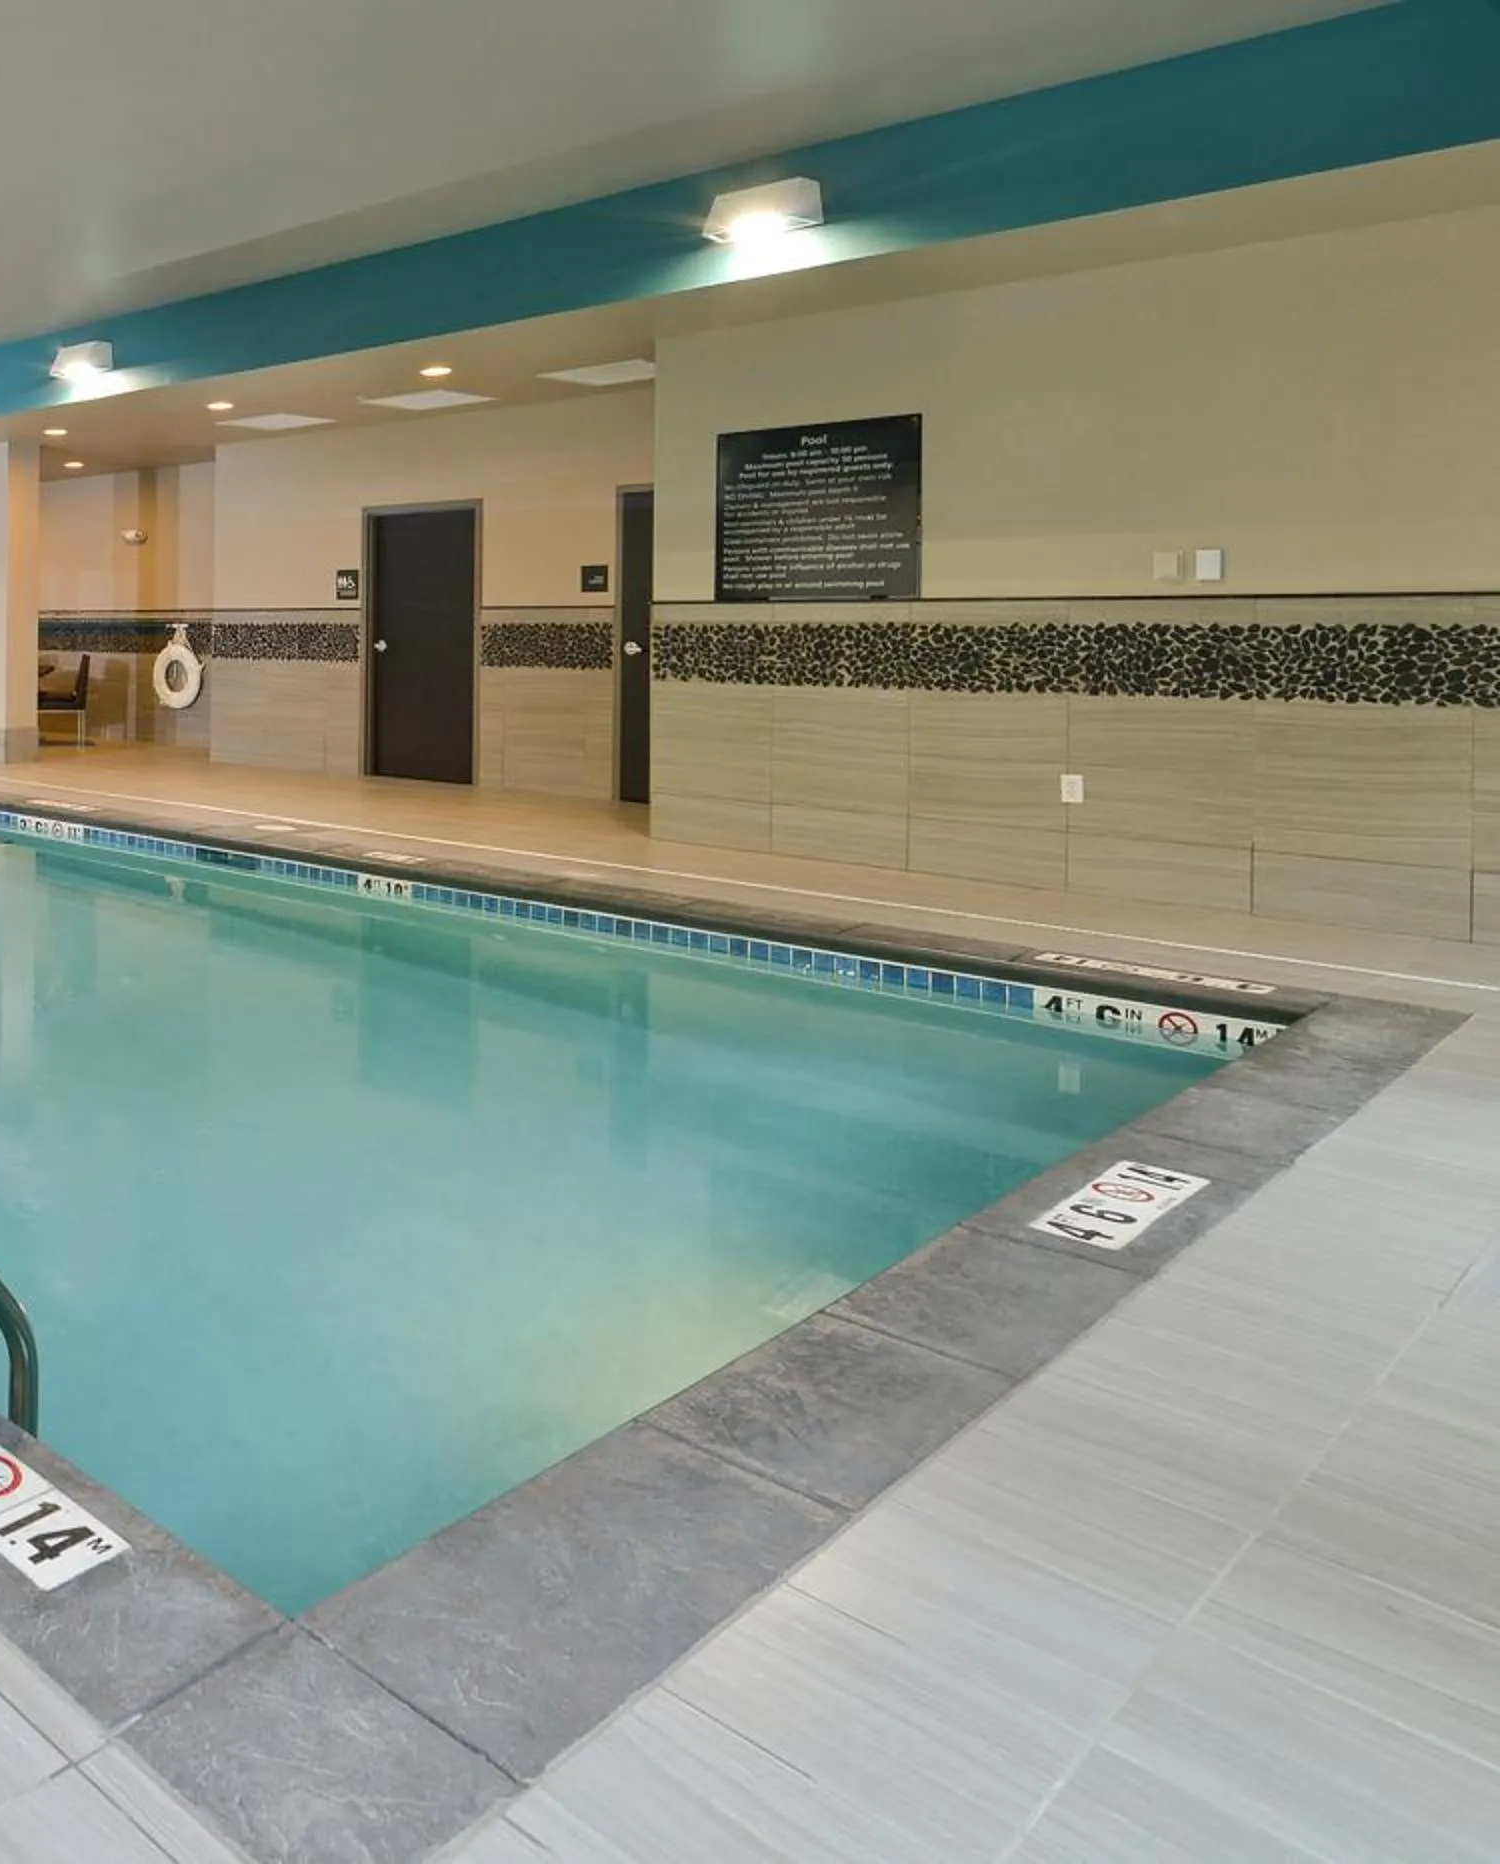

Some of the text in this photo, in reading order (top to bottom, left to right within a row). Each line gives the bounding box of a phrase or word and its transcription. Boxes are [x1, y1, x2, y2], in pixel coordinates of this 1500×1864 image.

[801, 434, 826, 446] Pool
[1043, 995, 1063, 1013] 4
[1069, 1203, 1139, 1225] 6
[1047, 1221, 1116, 1241] 4
